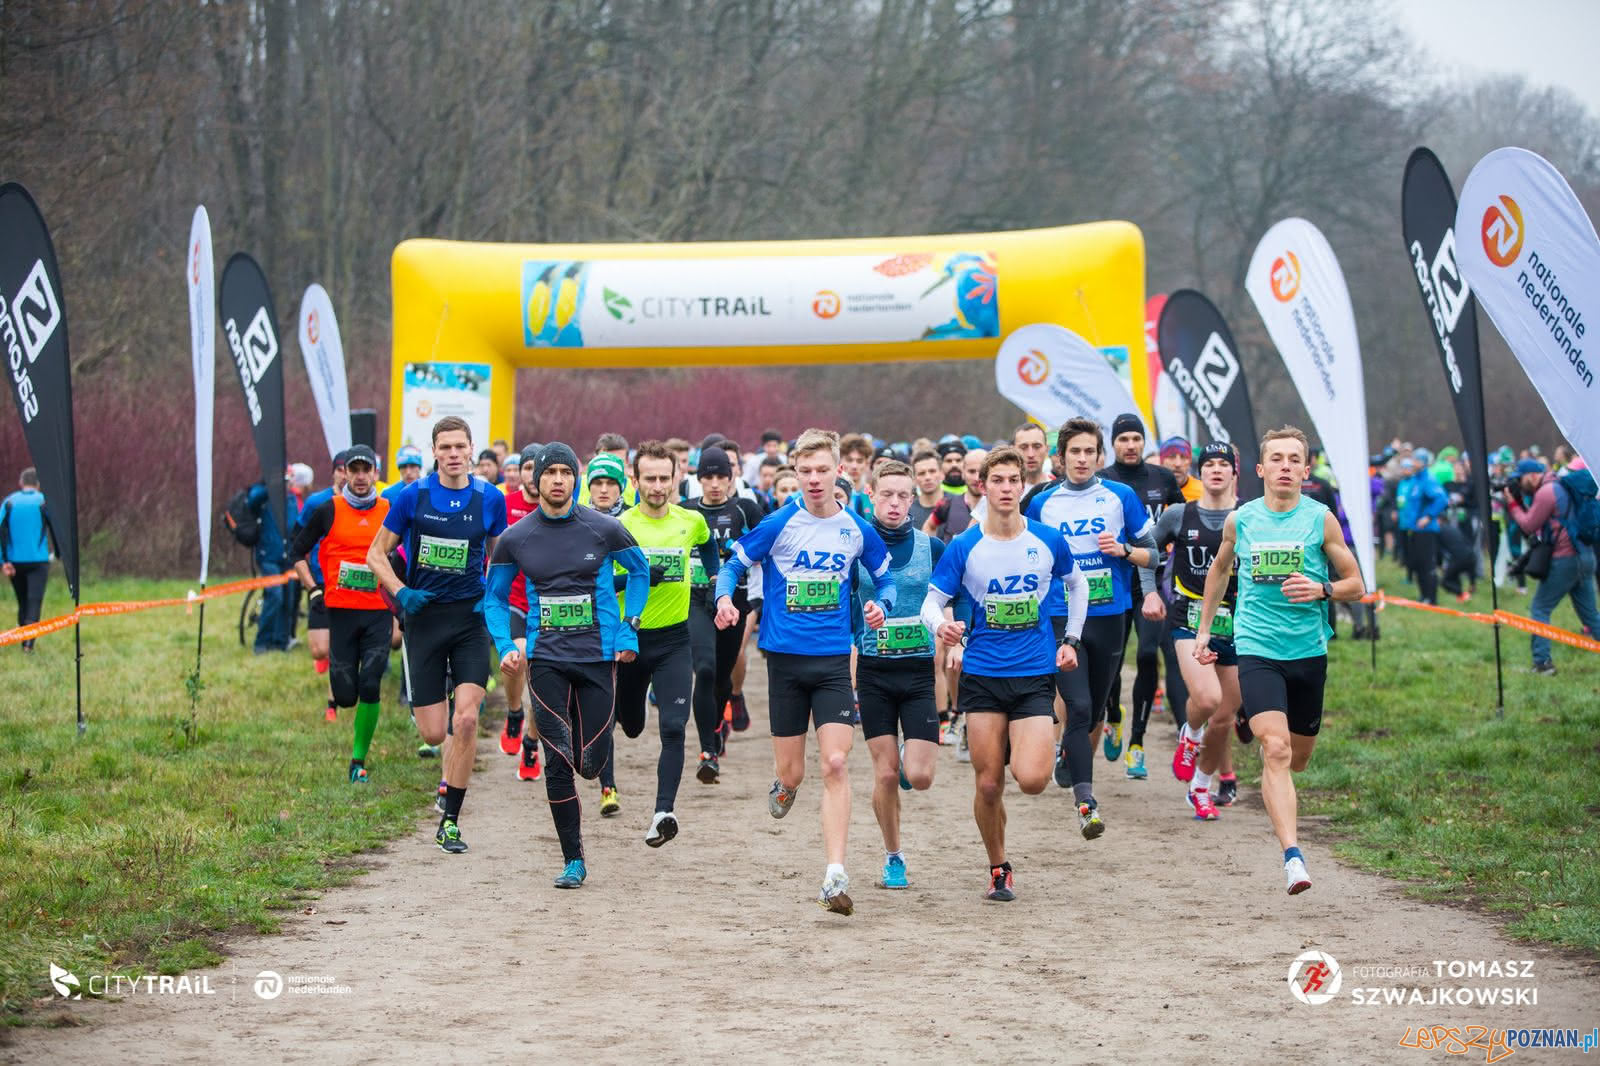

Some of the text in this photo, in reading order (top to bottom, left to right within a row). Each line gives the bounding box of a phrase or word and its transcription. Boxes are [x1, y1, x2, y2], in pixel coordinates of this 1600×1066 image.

[1527, 251, 1585, 339] nationale
[1517, 270, 1594, 388] nederlanden
[1060, 517, 1106, 537] AZS
[432, 545, 465, 560] 1023
[792, 550, 846, 571] AZS
[1264, 551, 1301, 566] 1025
[807, 582, 832, 596] 691
[987, 573, 1039, 595] AZS
[559, 605, 584, 617] 519
[1004, 600, 1031, 616] 261
[895, 625, 923, 640] 625
